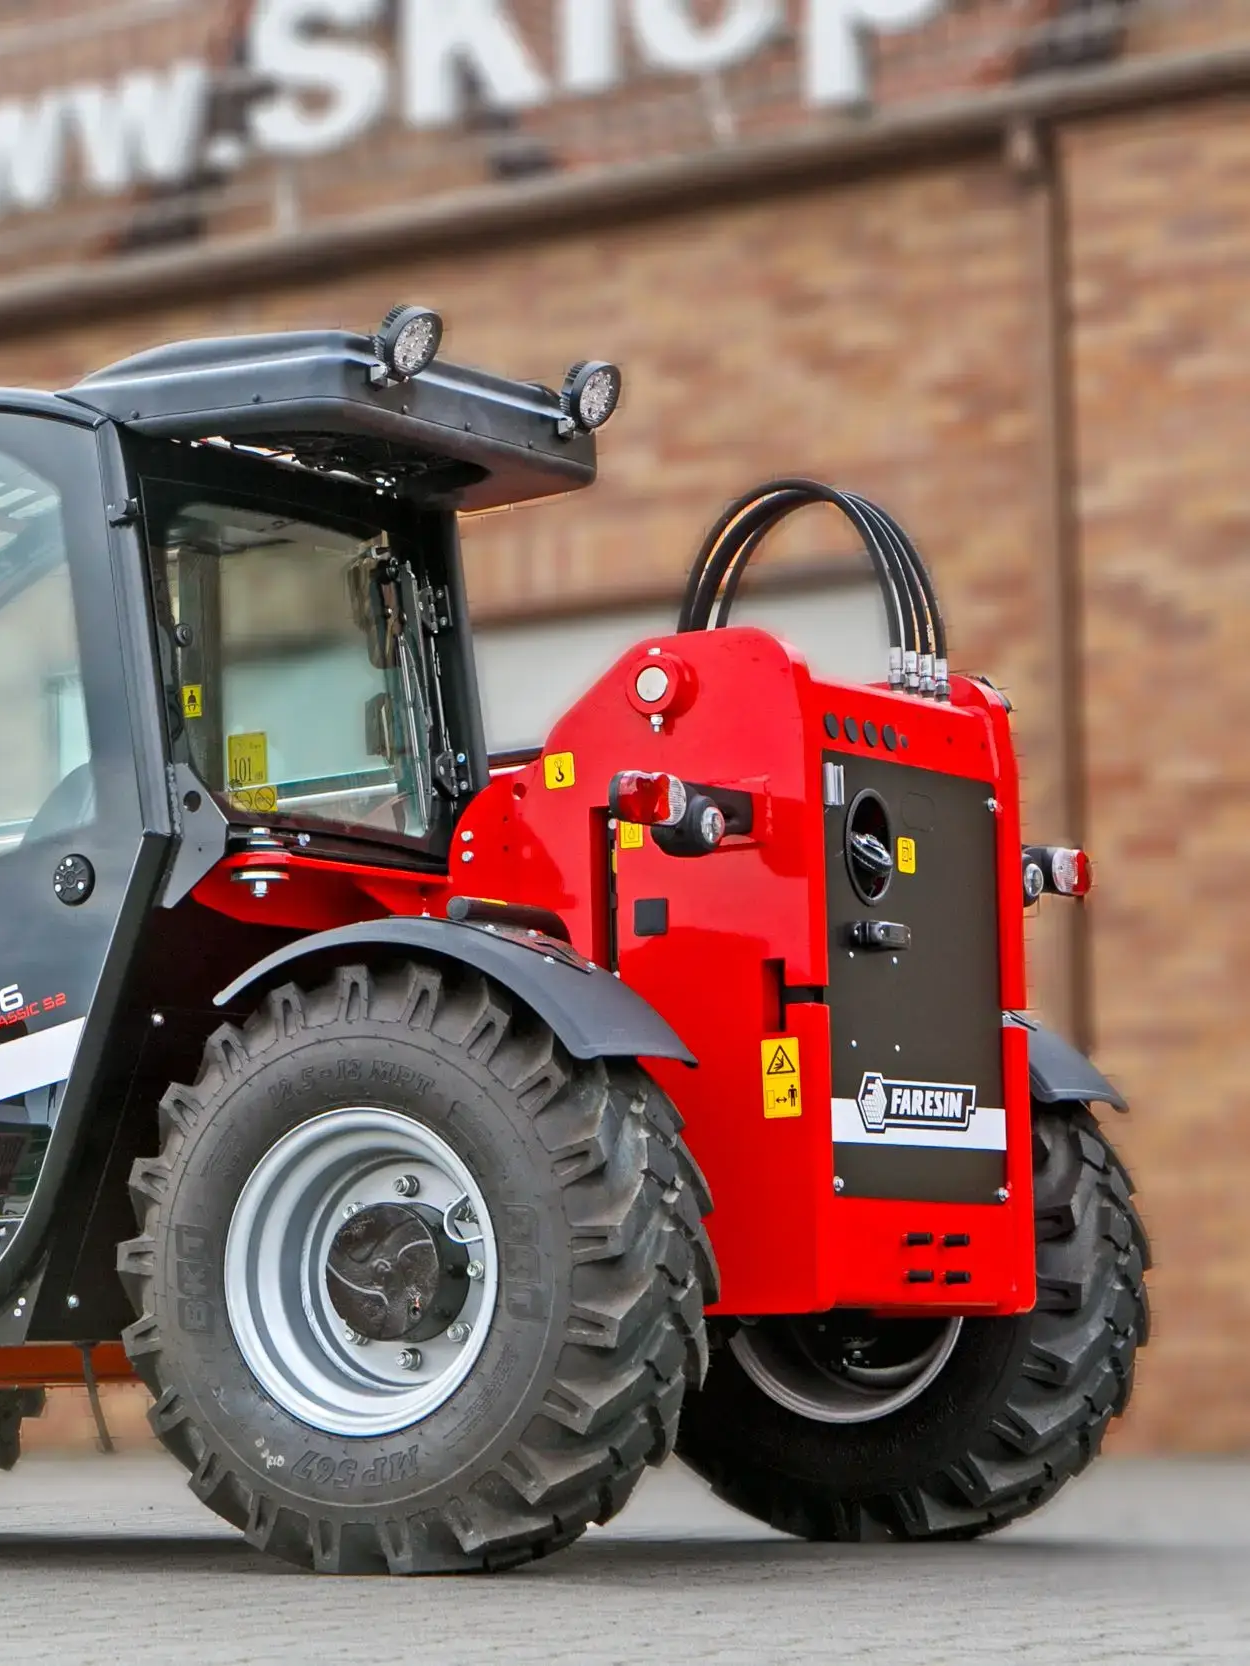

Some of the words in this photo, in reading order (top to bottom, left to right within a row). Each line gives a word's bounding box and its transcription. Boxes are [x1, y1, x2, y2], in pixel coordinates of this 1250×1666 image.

[41, 992, 67, 1012] S2
[369, 1060, 437, 1097] MPT
[889, 1087, 963, 1119] FARESIN
